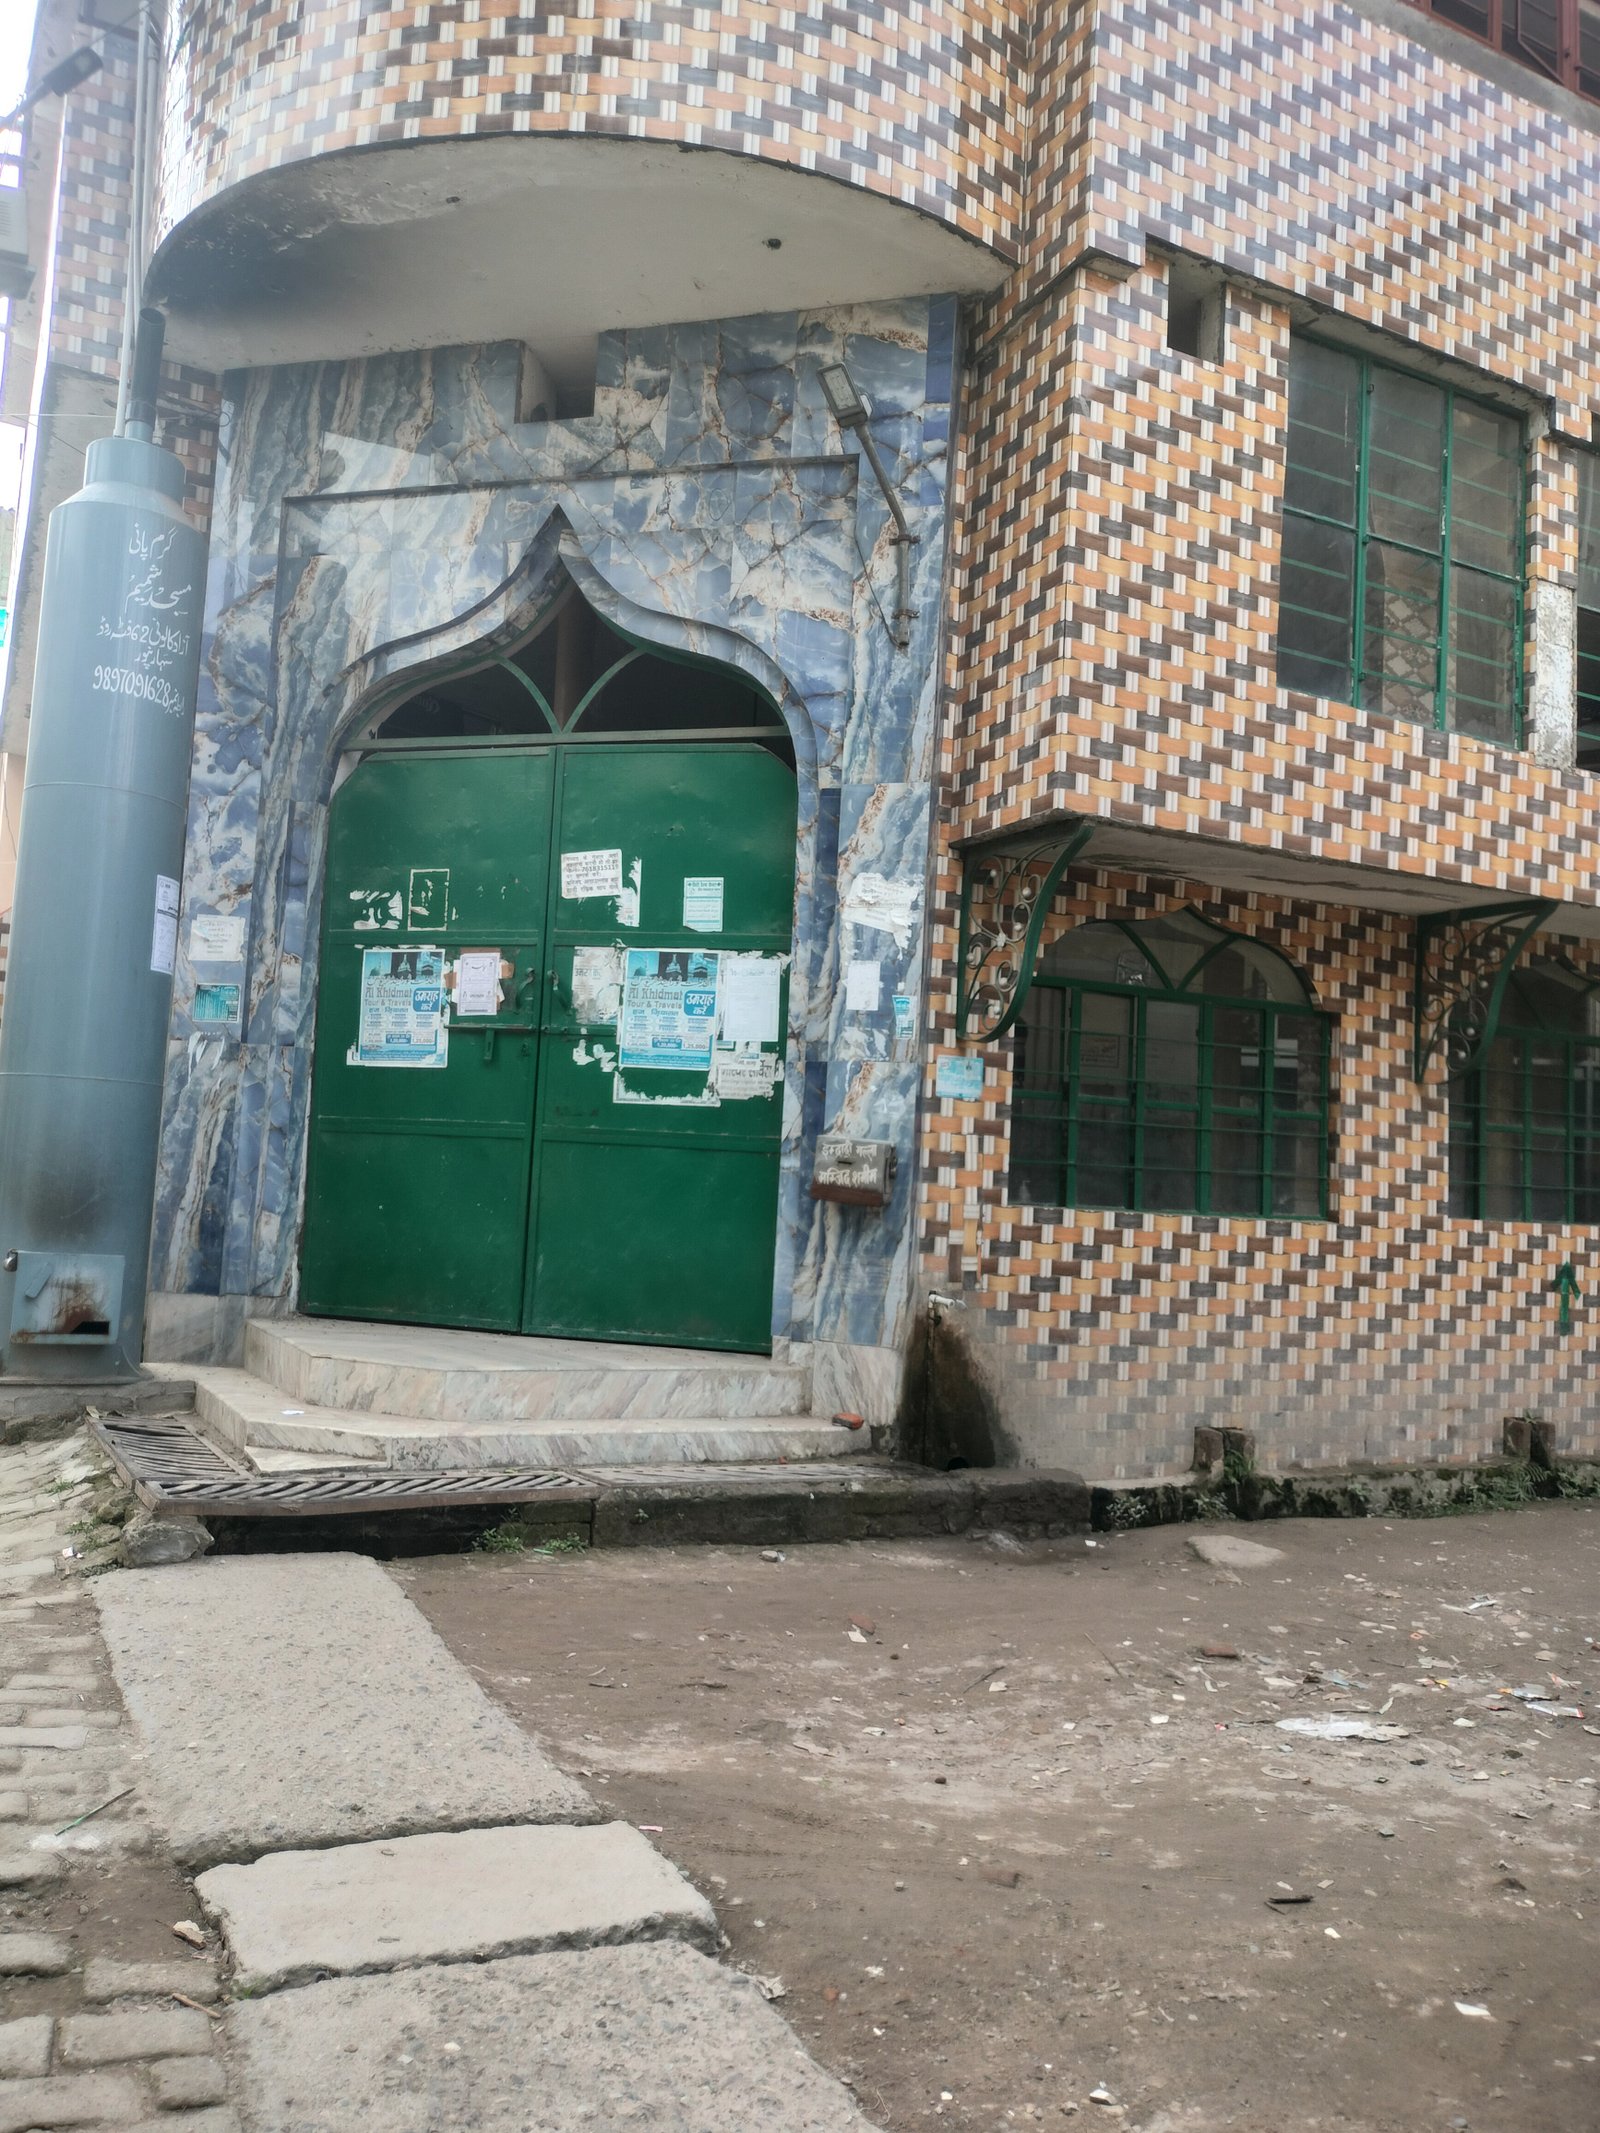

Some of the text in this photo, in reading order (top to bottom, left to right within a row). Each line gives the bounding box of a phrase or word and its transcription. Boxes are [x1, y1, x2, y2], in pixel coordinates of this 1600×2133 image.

[128, 522, 149, 560] پانی
[96, 615, 111, 636] روڈ
[92, 664, 171, 708] 9897091628
